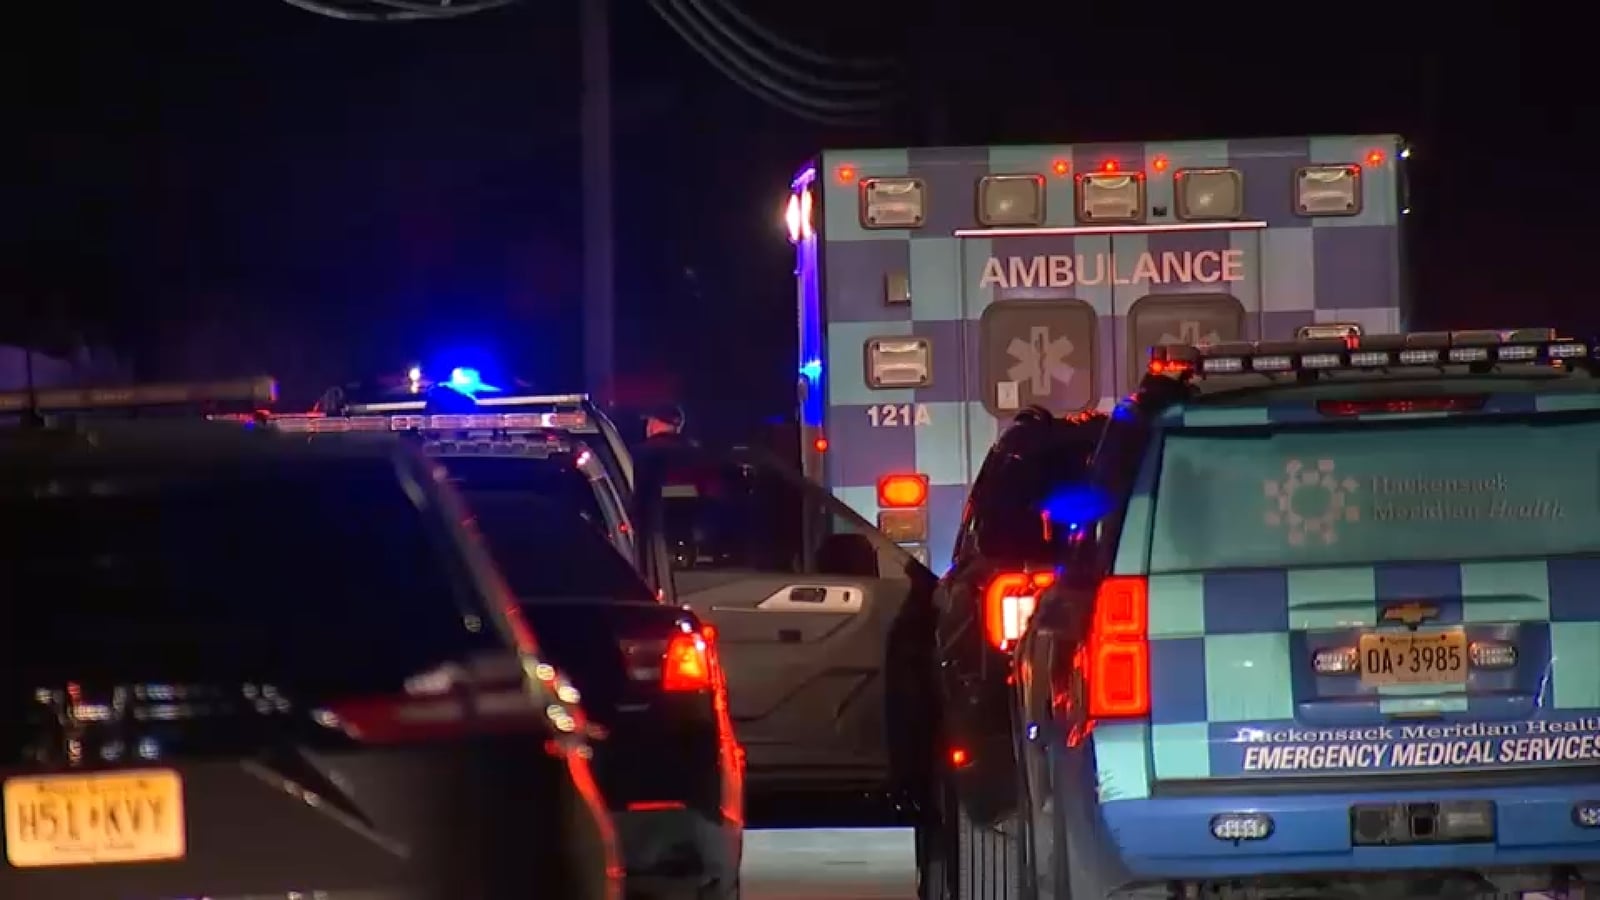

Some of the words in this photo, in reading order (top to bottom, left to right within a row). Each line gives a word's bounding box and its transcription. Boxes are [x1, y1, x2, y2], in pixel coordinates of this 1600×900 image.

[980, 249, 1245, 289] AMBULANCE
[866, 404, 932, 427] 121A
[1409, 645, 1461, 673] 3985
[1402, 721, 1518, 740] Meridian
[1243, 743, 1388, 771] EMERGENCY
[1391, 741, 1495, 767] MEDICAL
[1500, 735, 1600, 763] SERVICES
